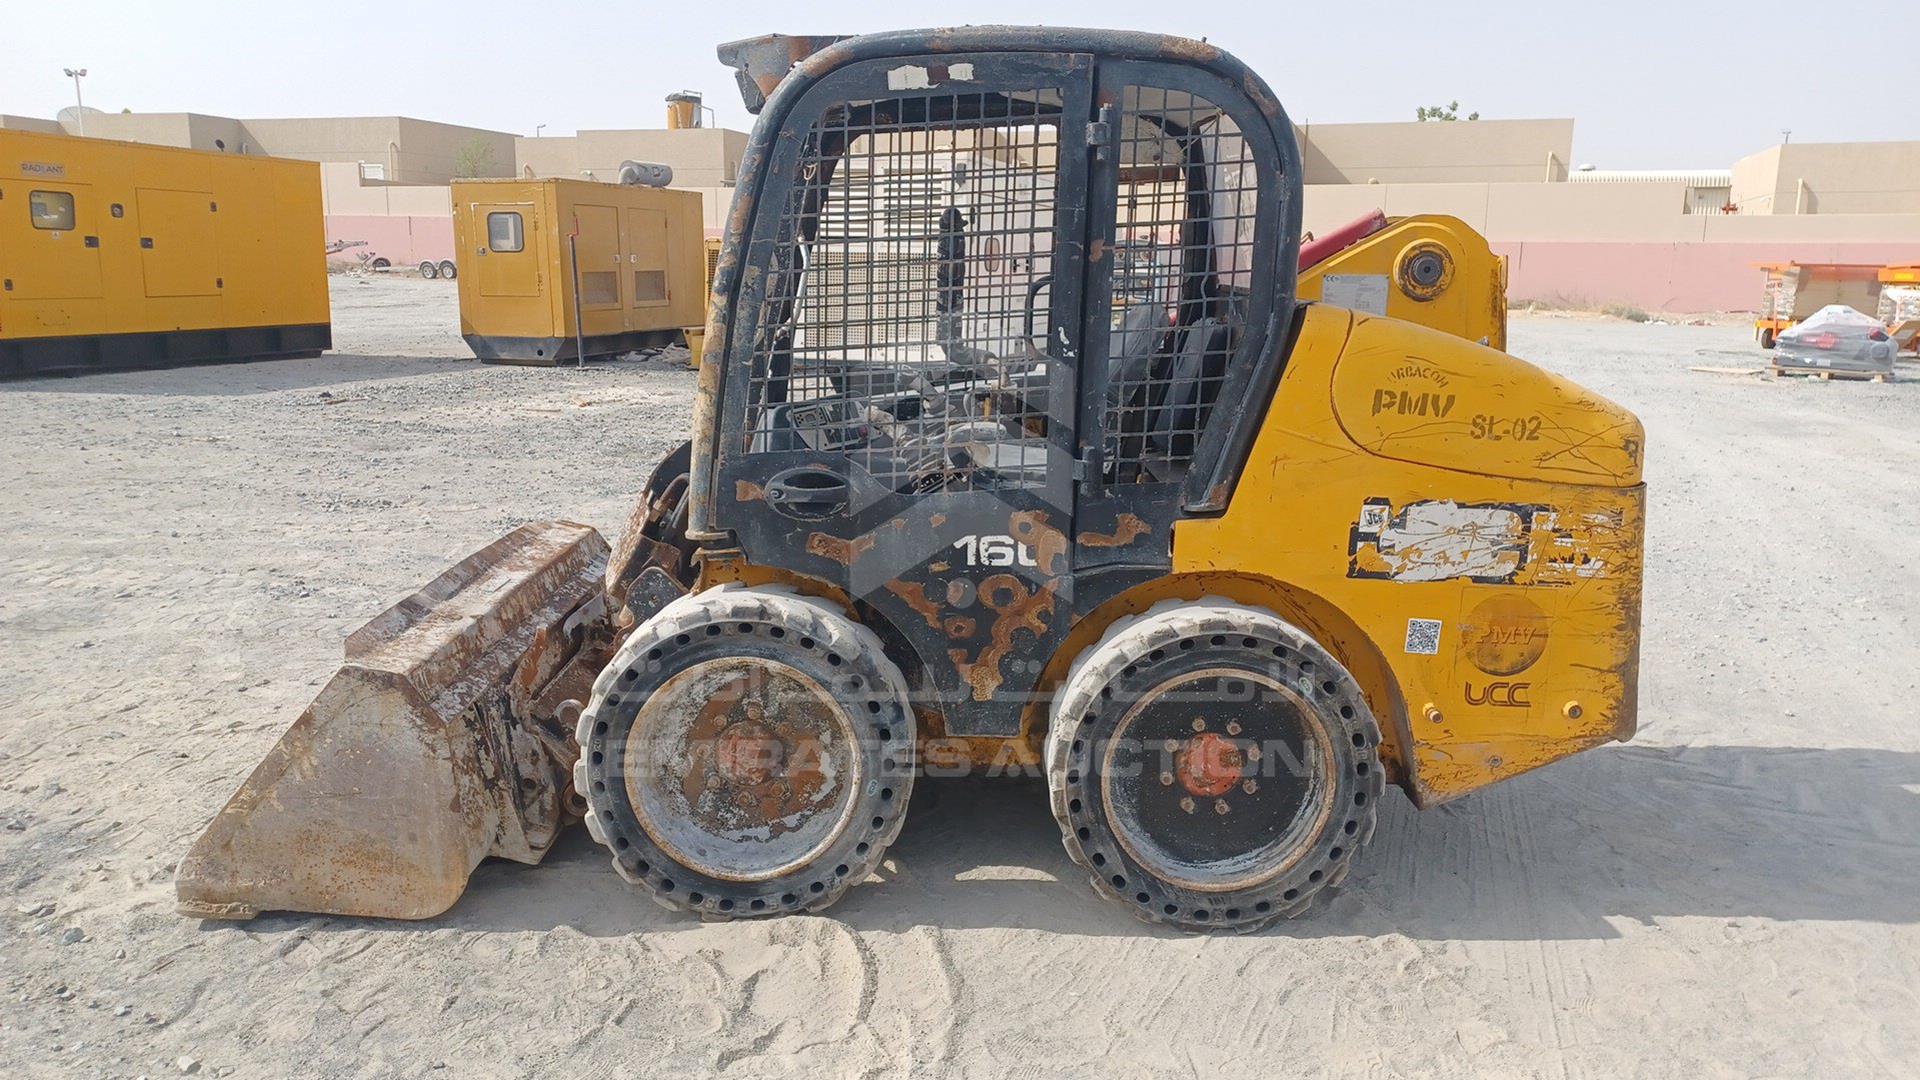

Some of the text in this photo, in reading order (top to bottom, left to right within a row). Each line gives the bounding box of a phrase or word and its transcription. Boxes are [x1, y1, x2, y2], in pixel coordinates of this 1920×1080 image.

[1372, 389, 1456, 418] PMV
[1470, 414, 1542, 441] SL-02
[1464, 681, 1532, 707] UCC
